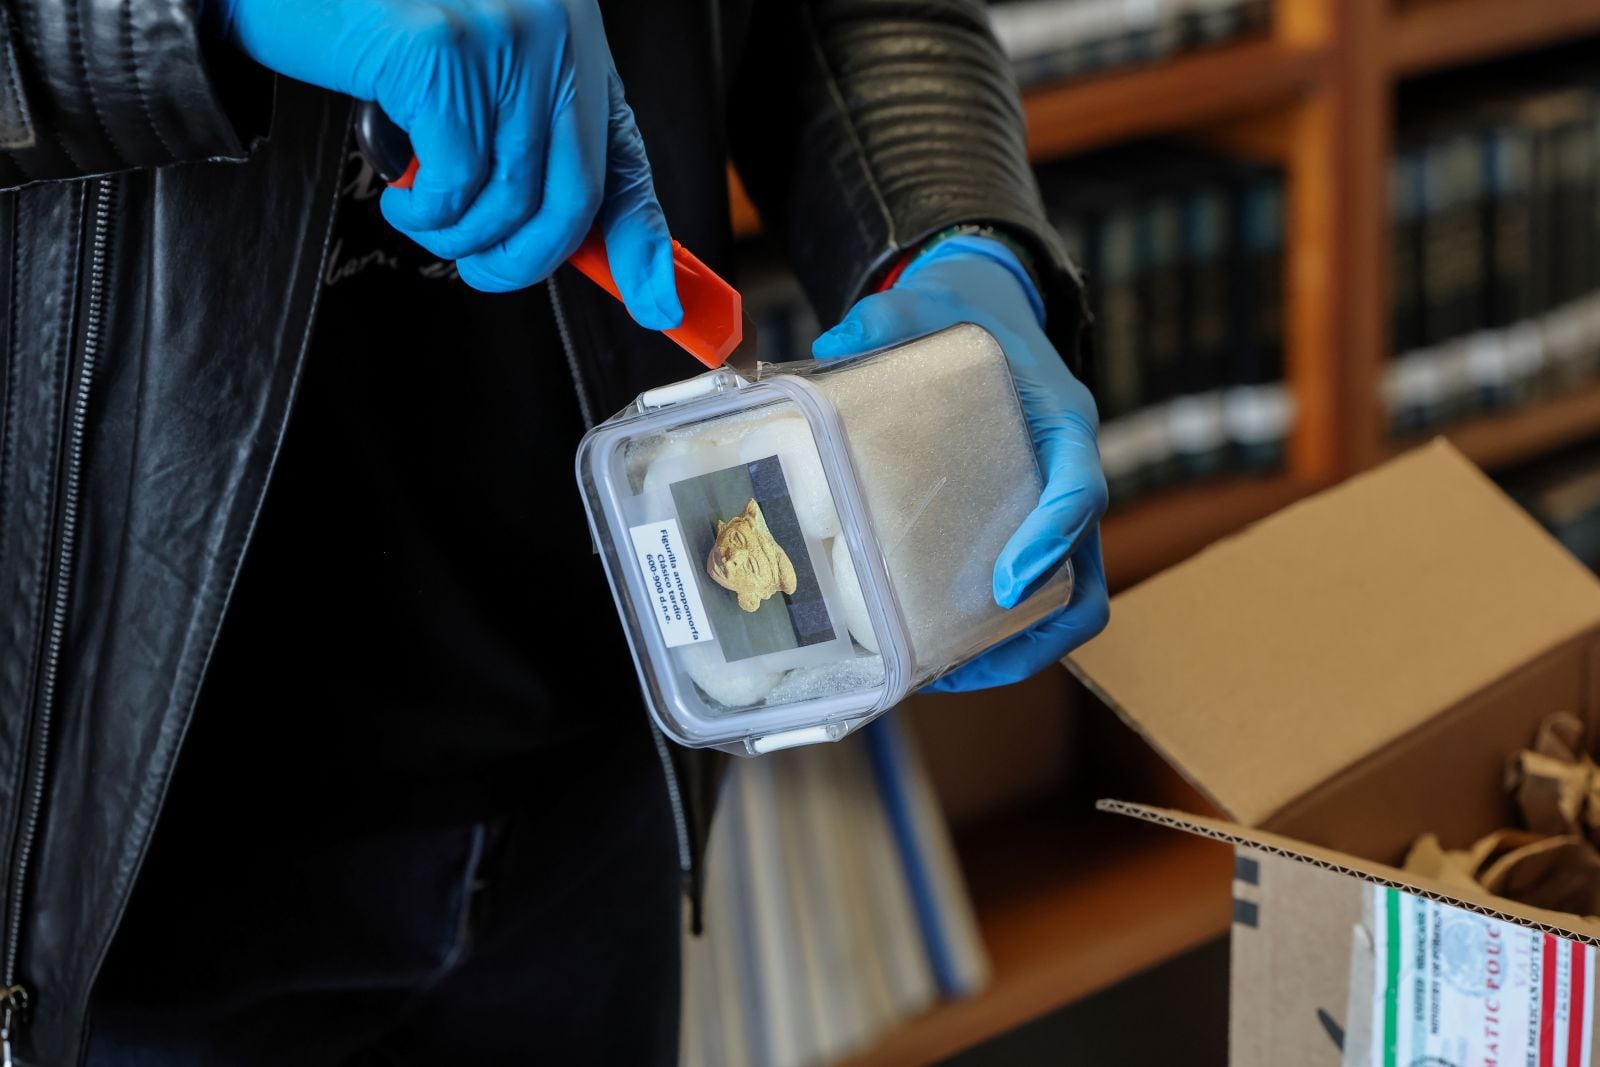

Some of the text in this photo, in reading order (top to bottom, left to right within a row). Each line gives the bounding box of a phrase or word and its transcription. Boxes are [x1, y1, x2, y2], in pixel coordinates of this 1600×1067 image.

[646, 553, 671, 624] 600-900 d.n.e.
[657, 553, 672, 589] Clásico
[660, 528, 699, 641] Figurilla antropomorfa
